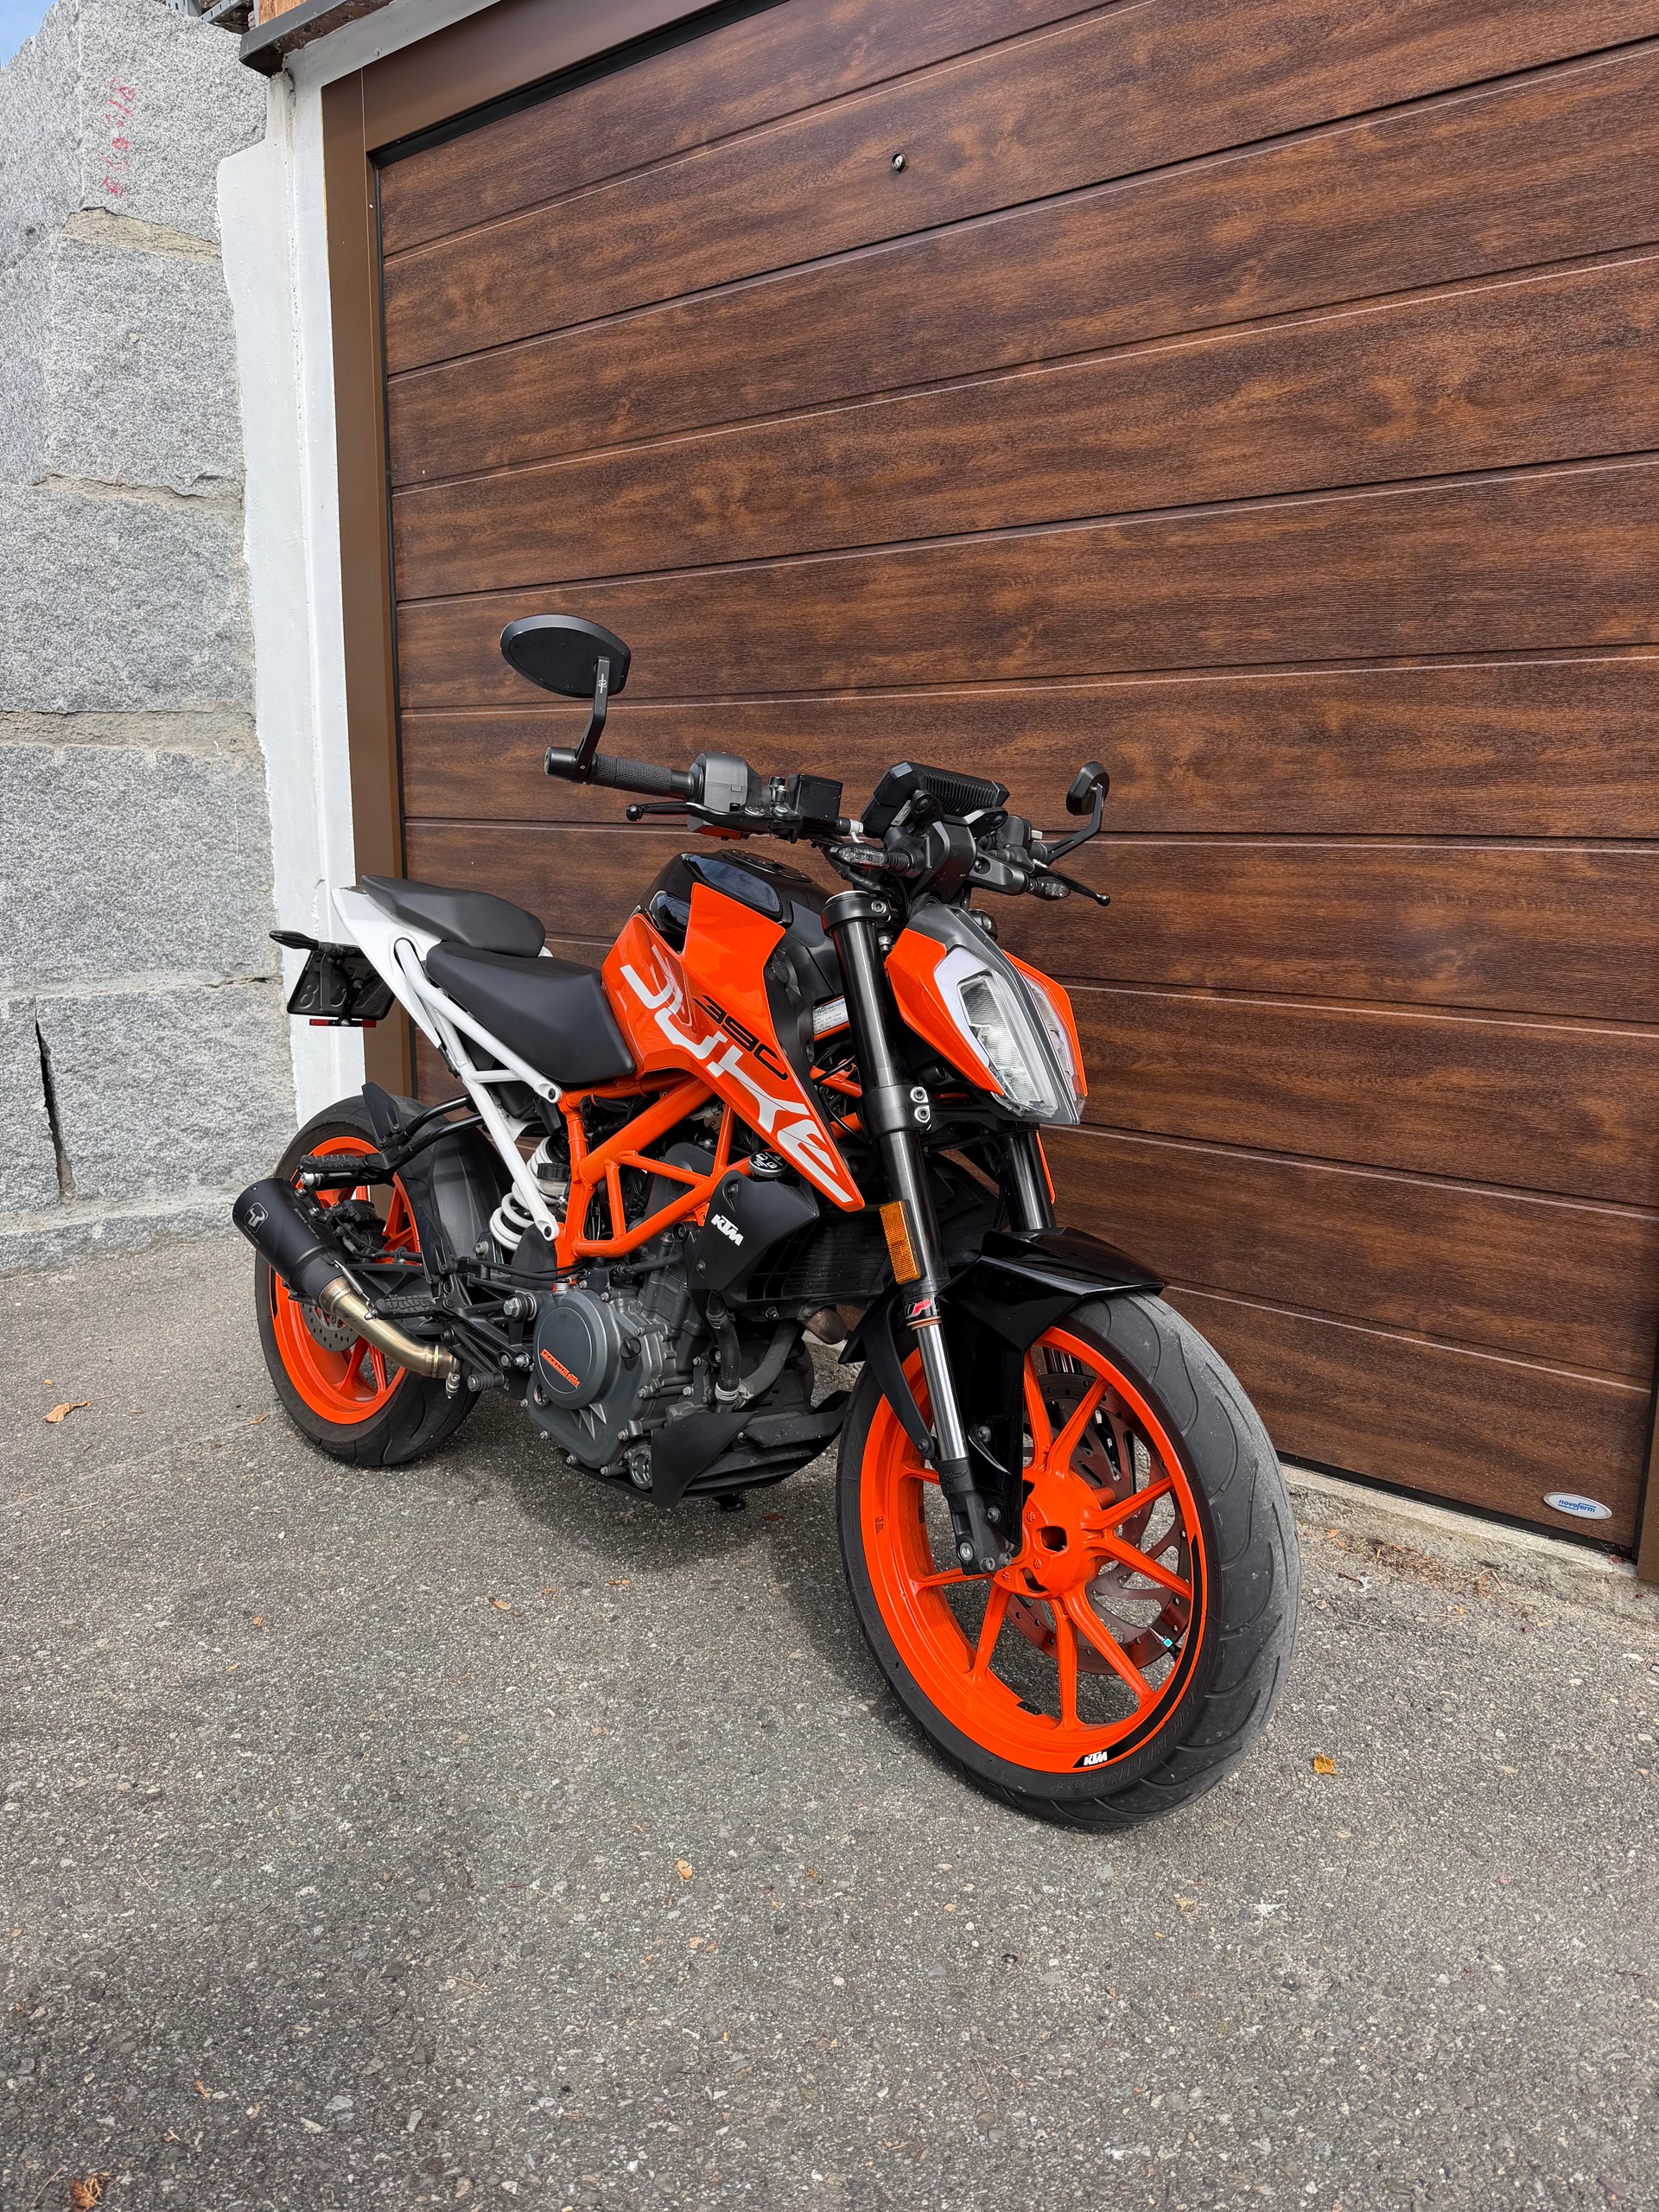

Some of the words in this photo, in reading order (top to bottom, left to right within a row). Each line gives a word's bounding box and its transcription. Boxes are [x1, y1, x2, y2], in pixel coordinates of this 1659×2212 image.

[692, 994, 788, 1081] 390
[620, 944, 854, 1202] DUKE
[710, 1213, 744, 1246] KTM
[1558, 1499, 1597, 1513] novoferm
[1083, 1751, 1108, 1766] KTM
